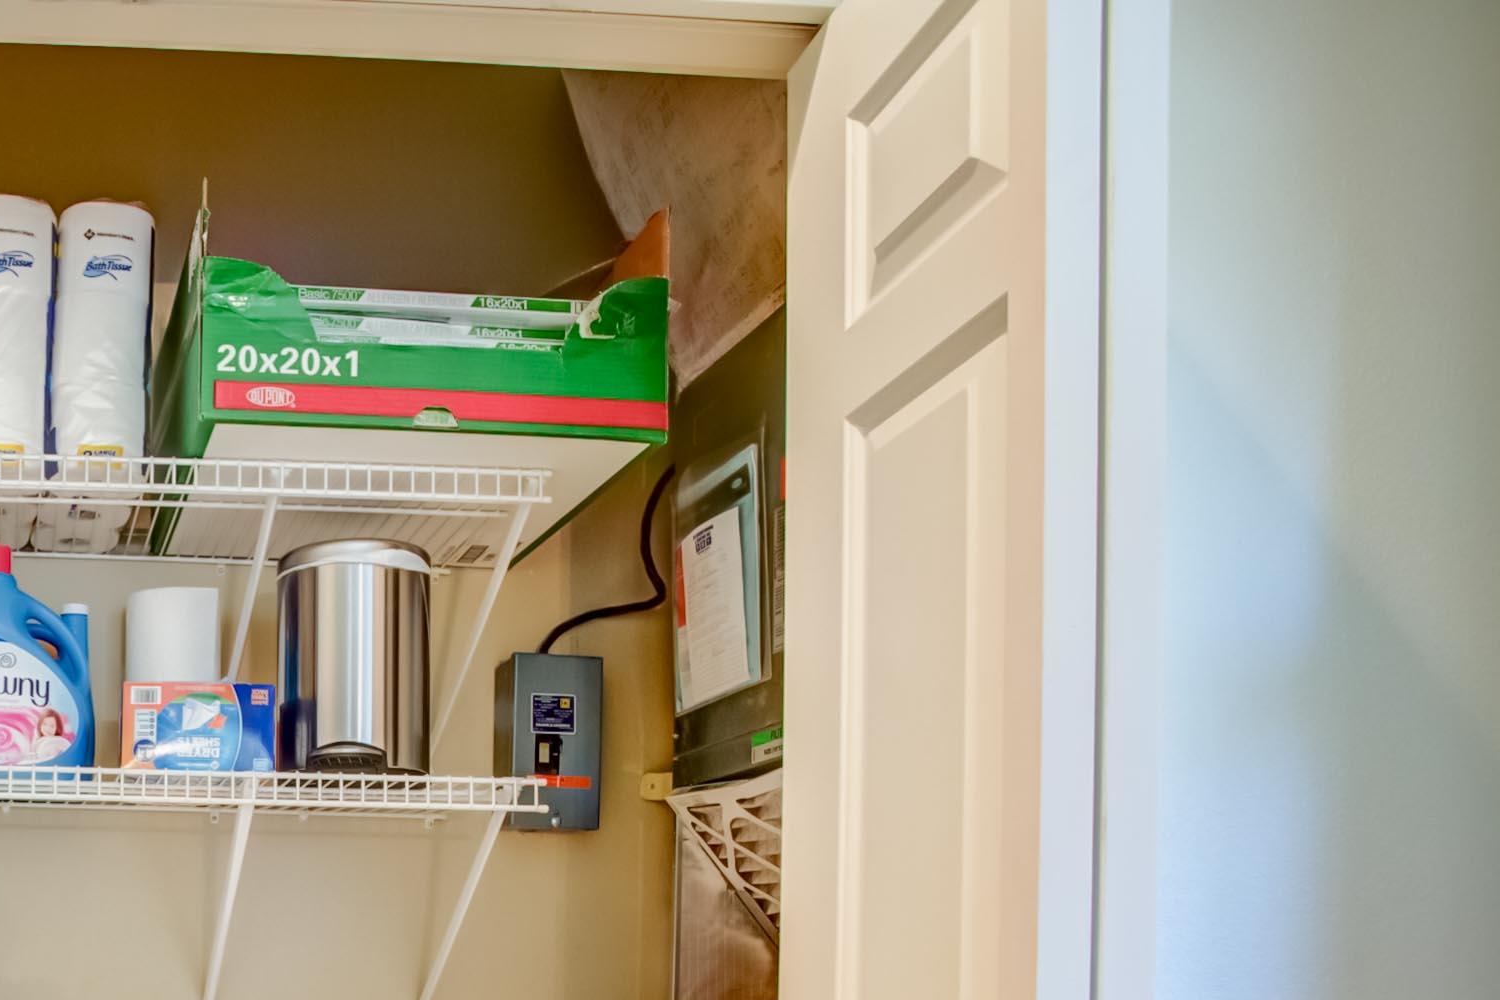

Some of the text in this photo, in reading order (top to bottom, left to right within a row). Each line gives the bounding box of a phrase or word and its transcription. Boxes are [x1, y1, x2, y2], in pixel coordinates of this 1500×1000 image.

[7, 256, 34, 269] Tissue
[85, 260, 133, 273] Bath Tissue
[299, 287, 330, 299] Basic
[479, 296, 528, 311] 16x20x1
[216, 343, 360, 377] 20x20x1
